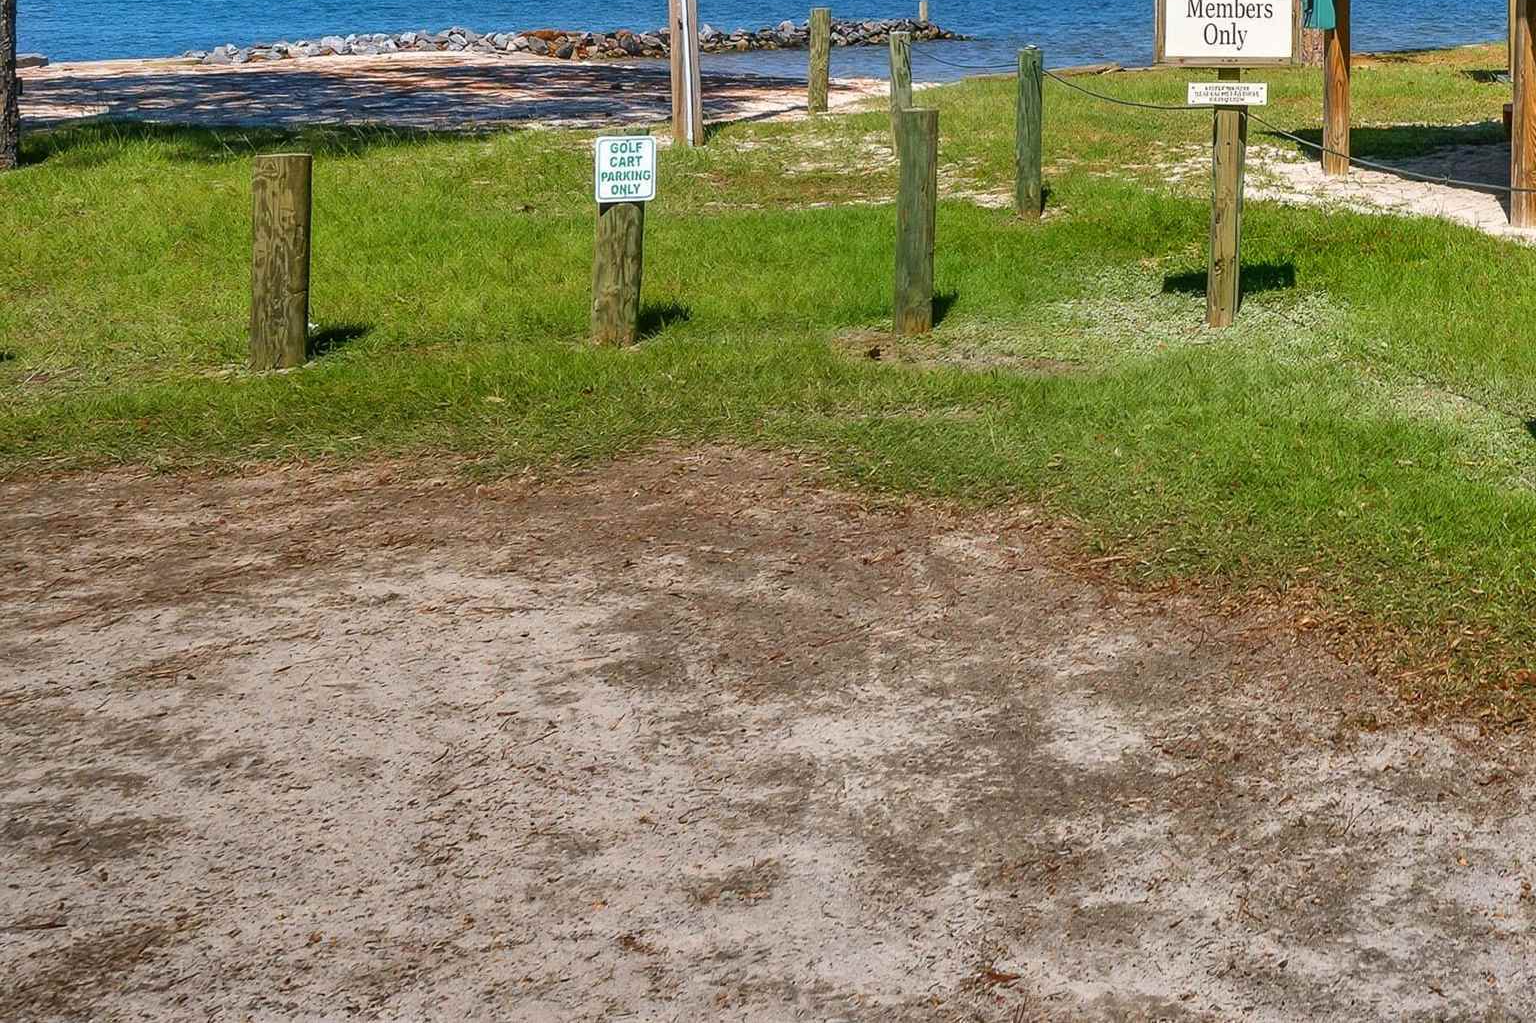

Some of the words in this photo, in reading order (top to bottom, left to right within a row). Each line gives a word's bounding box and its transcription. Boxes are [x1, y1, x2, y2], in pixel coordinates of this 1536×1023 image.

[1203, 22, 1248, 51] Only
[610, 142, 643, 154] GOLF
[609, 156, 643, 168] CART
[601, 170, 651, 182] PARKING
[611, 184, 641, 195] ONLY
